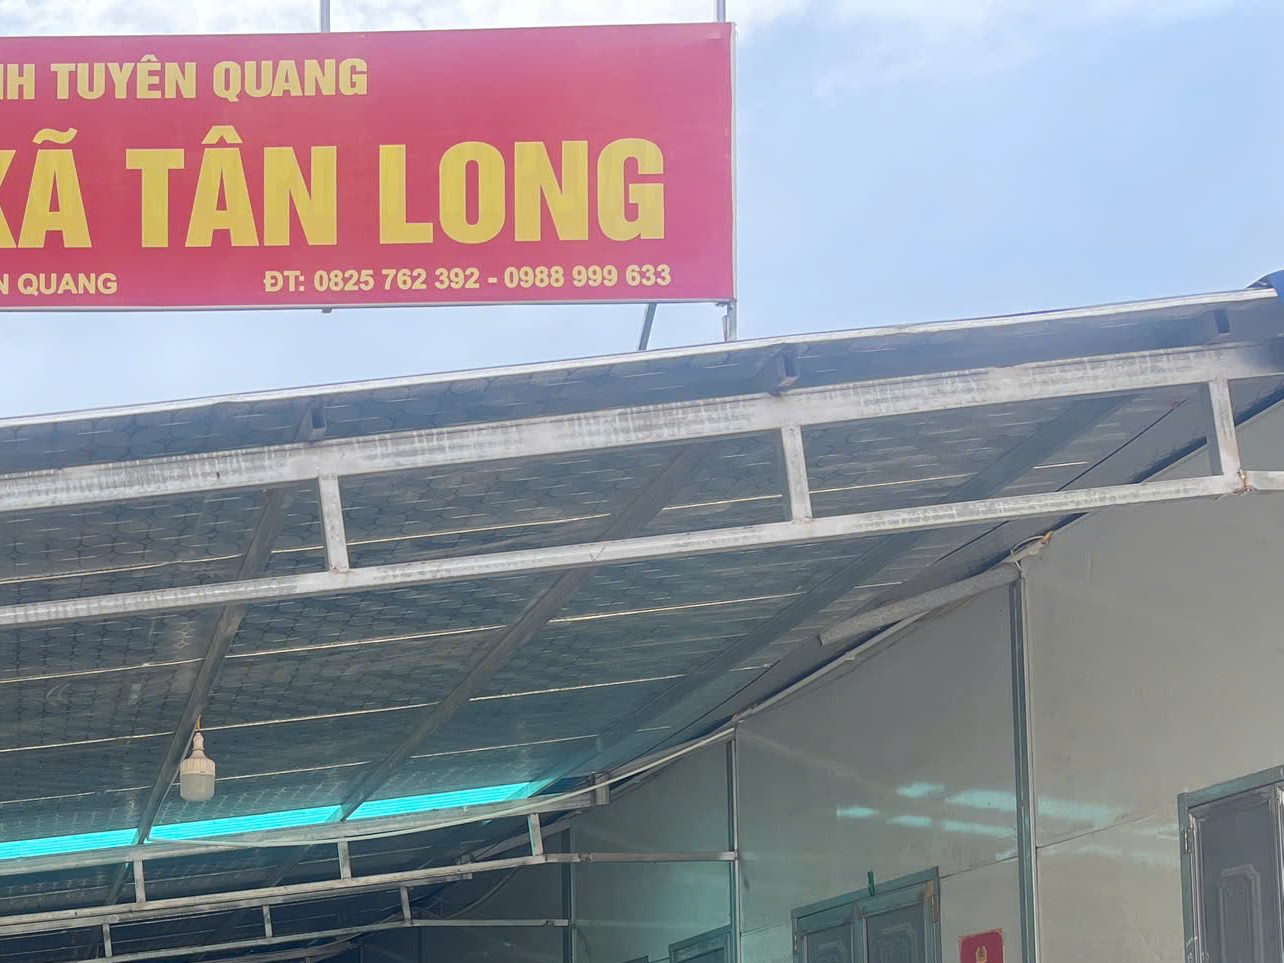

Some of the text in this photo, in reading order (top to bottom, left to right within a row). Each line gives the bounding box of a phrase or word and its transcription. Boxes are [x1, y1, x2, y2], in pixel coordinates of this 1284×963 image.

[50, 53, 197, 100] TUYÊN
[212, 57, 368, 103] QUANG
[125, 124, 338, 248] TÂN
[379, 137, 665, 245] LONG
[17, 272, 118, 297] QUANG
[262, 270, 305, 293] ĐT:
[313, 269, 375, 292] 0825
[381, 267, 428, 291] 762
[434, 267, 480, 290] 392
[503, 265, 565, 289] 0988
[571, 264, 619, 288] 999
[625, 263, 672, 287] 633
